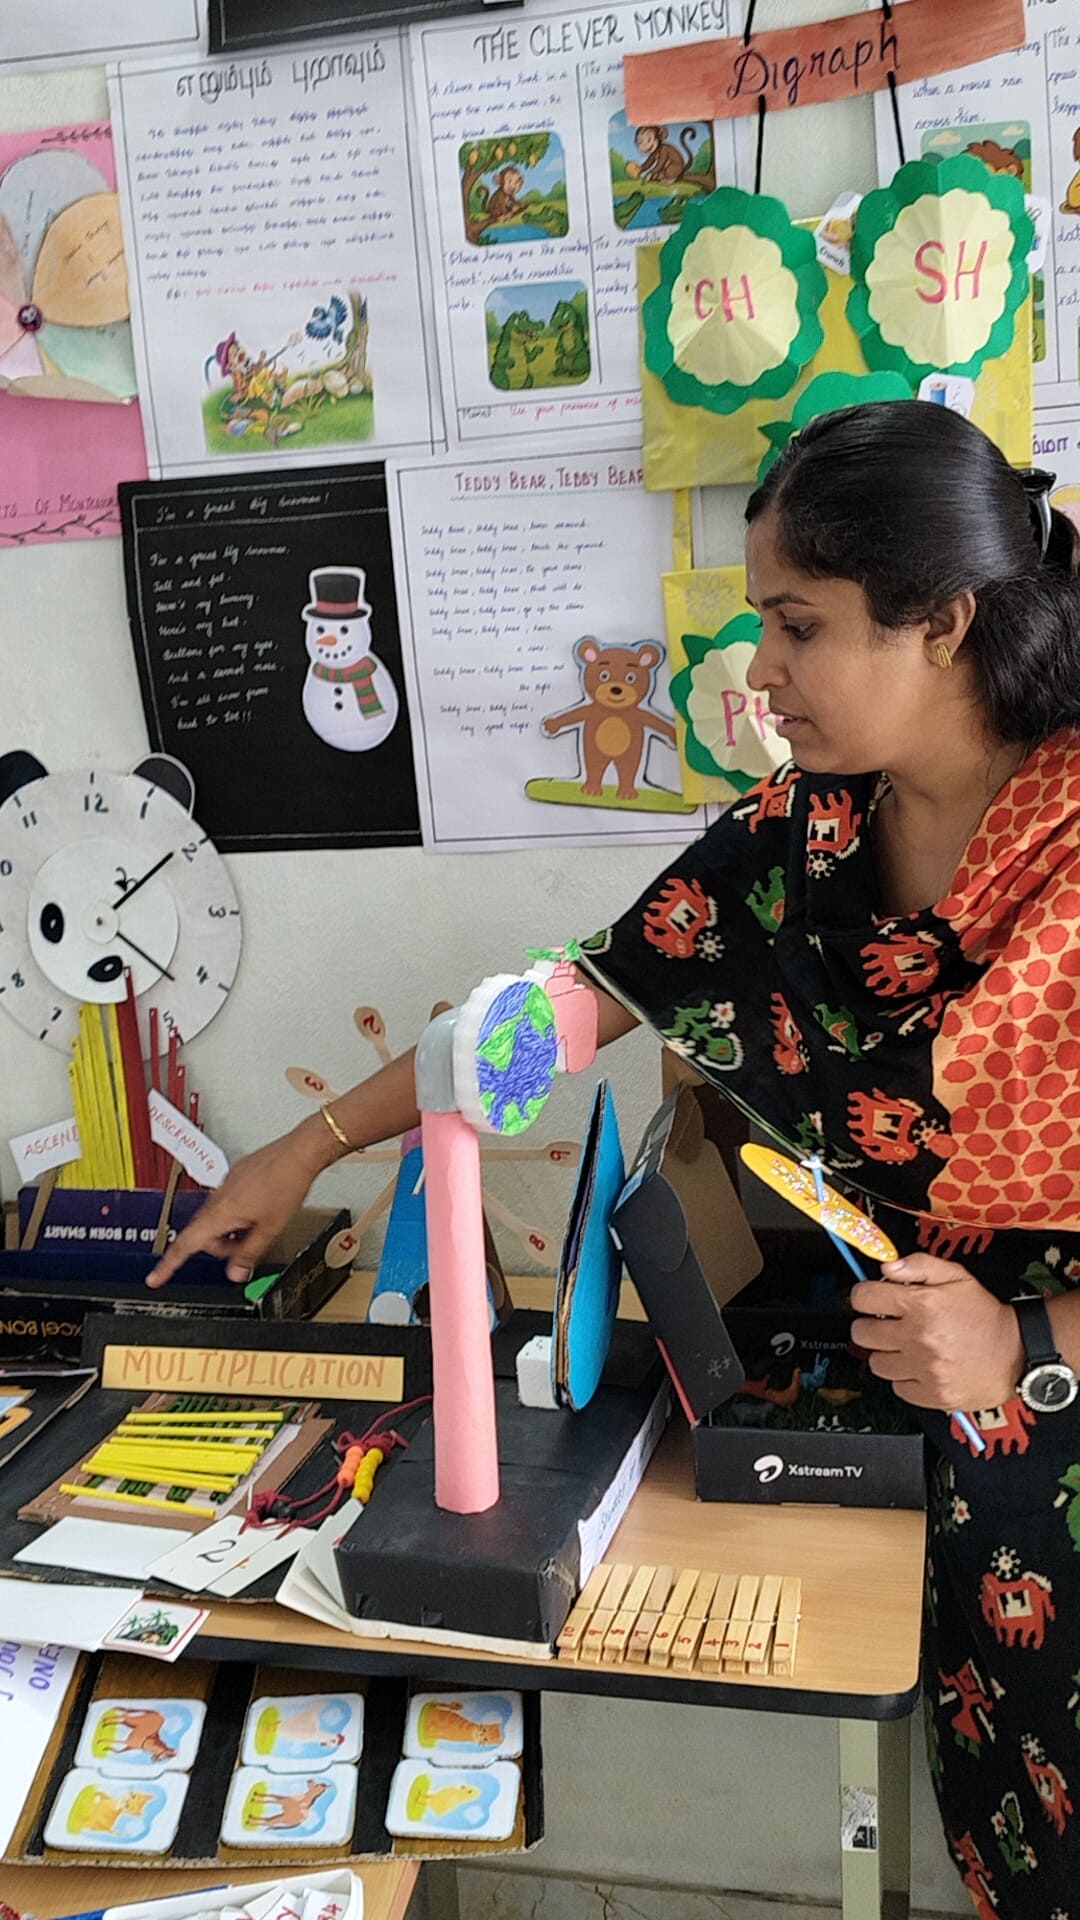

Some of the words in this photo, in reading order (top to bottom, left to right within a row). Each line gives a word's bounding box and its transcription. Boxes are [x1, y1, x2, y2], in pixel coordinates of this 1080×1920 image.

[473, 27, 520, 64] THE
[530, 14, 623, 54] CLEVER
[635, 1, 726, 41] MONKEY
[726, 30, 900, 106] Digraph
[914, 240, 988, 304] SH
[694, 274, 755, 323] CH
[455, 472, 500, 492] TEDDY
[556, 467, 598, 488] TEDDY
[83, 793, 109, 814] 12
[22, 811, 38, 829] 11
[181, 841, 198, 862] 2
[208, 905, 226, 919] 3
[11, 971, 26, 989] 8
[196, 966, 209, 985] 4
[51, 1007, 62, 1021] 7
[362, 1014, 383, 1036] 2
[304, 1074, 325, 1092] 3
[149, 1105, 217, 1172] DESCENDING
[44, 1225, 87, 1240] SMART
[90, 1226, 123, 1241] BORN
[338, 1233, 359, 1252] 5
[528, 1233, 547, 1252] 8
[800, 1340, 849, 1351] Xstream
[122, 1348, 385, 1390] MULTIPLICATION
[196, 1538, 238, 1564] 2
[563, 1626, 576, 1637] 10
[655, 1631, 670, 1640] 6
[676, 1635, 692, 1645] 5
[704, 1637, 721, 1648] 4
[724, 1638, 741, 1648] 3
[747, 1642, 763, 1650] 2
